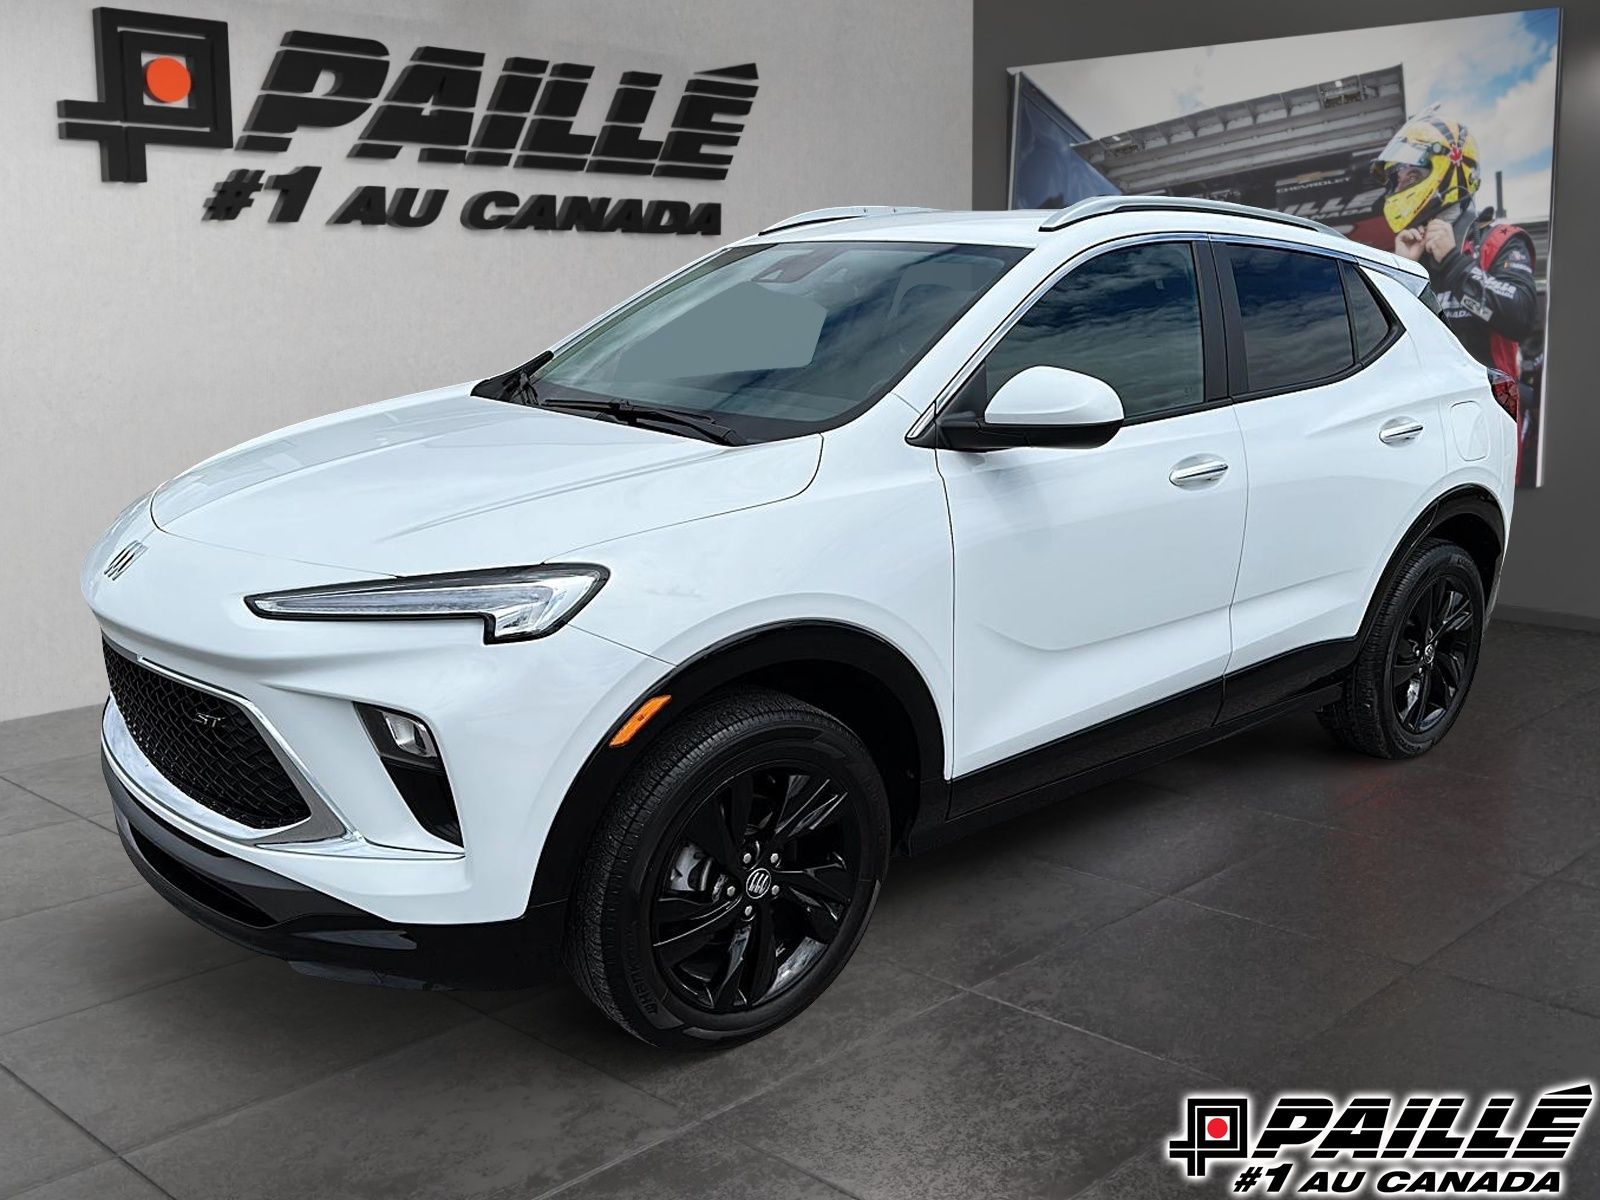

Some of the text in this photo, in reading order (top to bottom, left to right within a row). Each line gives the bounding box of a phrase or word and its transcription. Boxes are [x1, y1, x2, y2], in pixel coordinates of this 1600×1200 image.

[234, 30, 760, 181] PAILLÉ
[201, 166, 722, 236] #1 AU CANADA
[1276, 176, 1351, 194] CHEVROLET
[193, 712, 227, 728] ST
